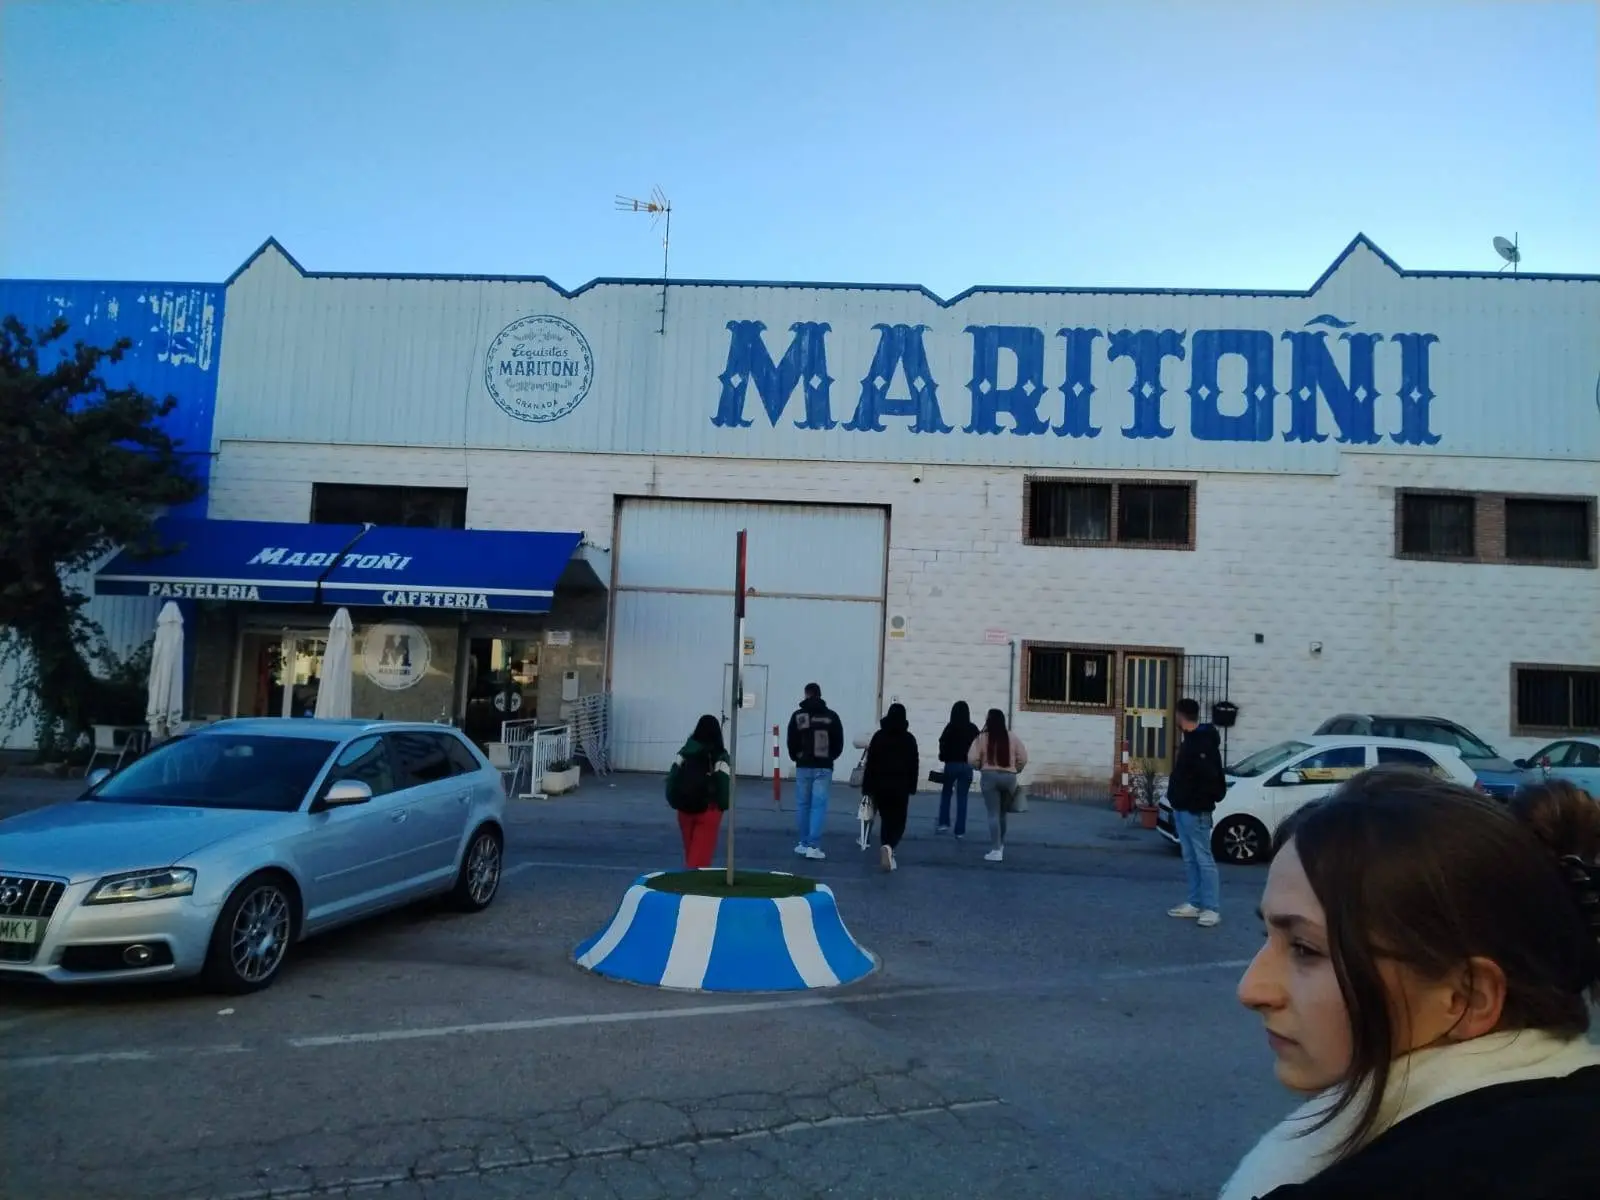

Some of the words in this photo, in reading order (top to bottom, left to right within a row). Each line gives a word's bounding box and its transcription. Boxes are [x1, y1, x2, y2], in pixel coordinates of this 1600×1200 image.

[499, 359, 579, 376] MARITOÑI
[710, 313, 1441, 445] MARITOÑI
[516, 398, 557, 409] GRANADA
